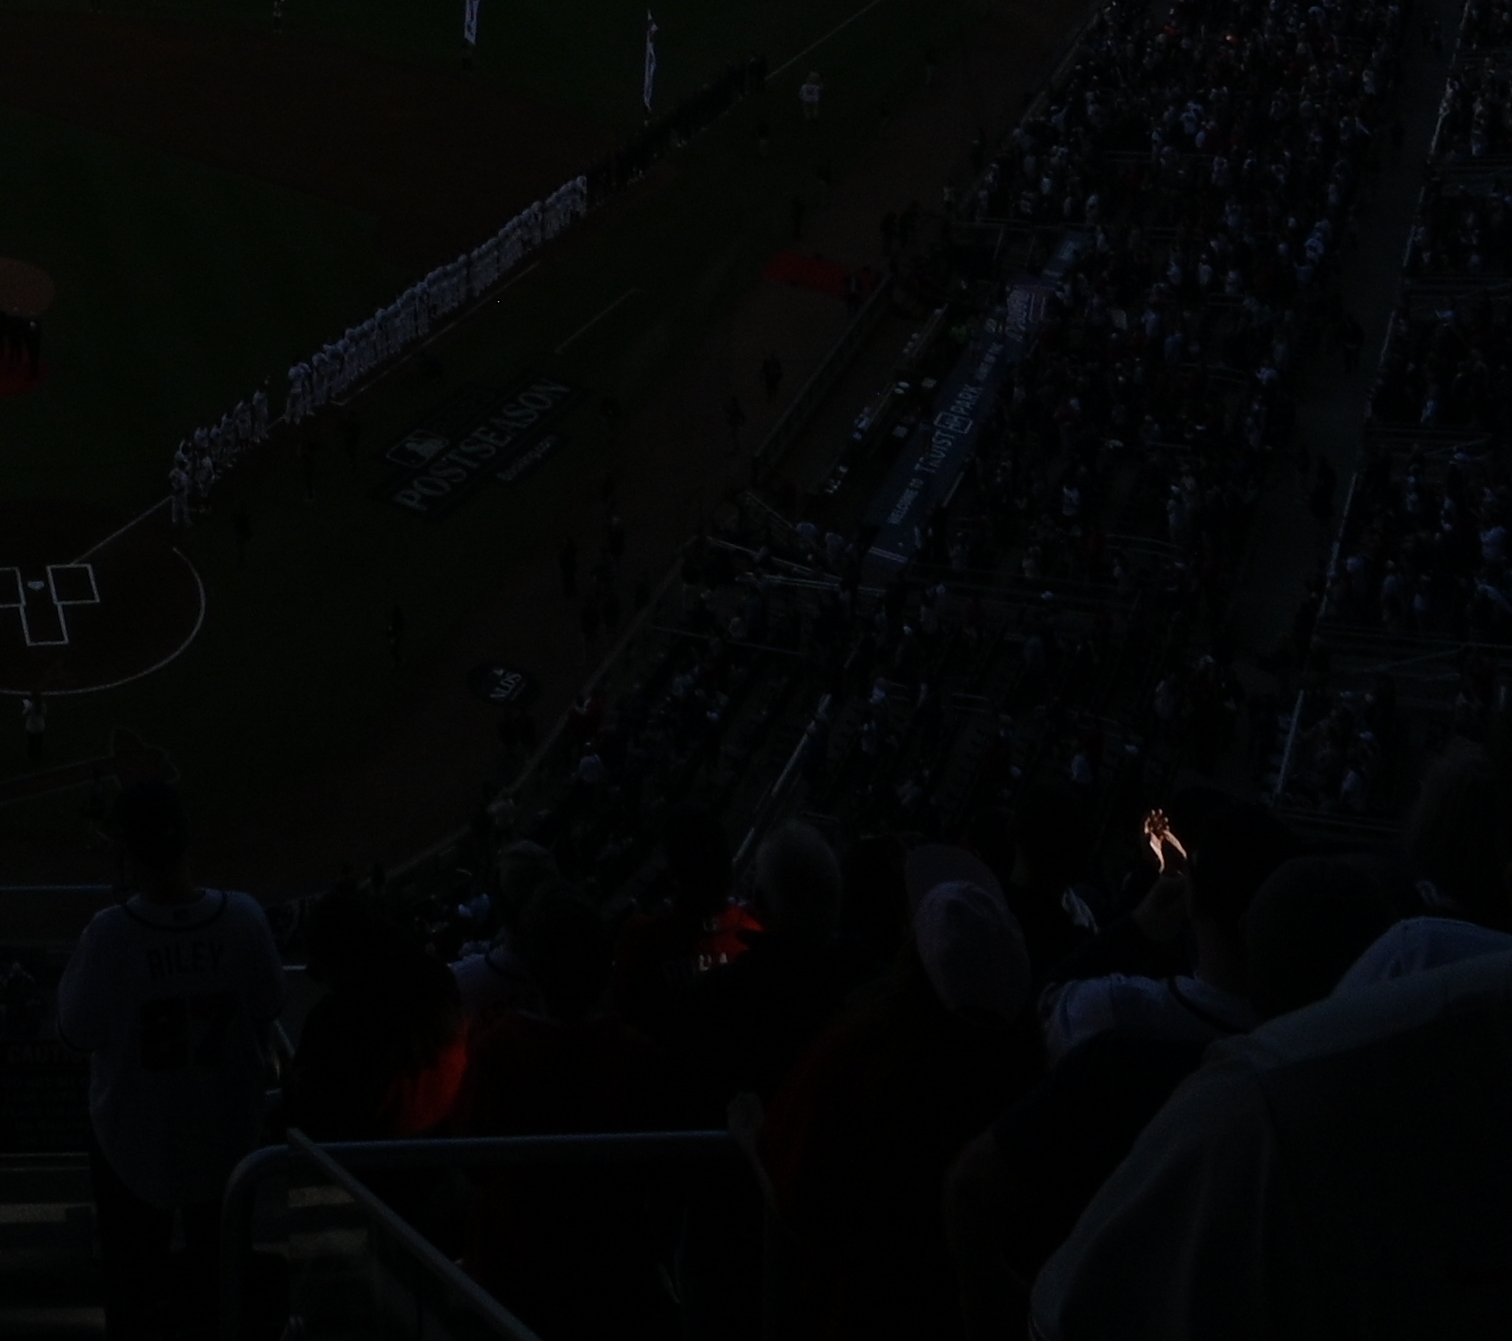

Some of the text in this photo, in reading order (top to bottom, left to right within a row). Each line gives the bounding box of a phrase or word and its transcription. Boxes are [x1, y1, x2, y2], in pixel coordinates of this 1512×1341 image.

[393, 377, 571, 512] POSTSEASON
[148, 942, 225, 980] RILEY
[140, 991, 238, 1070] 27
